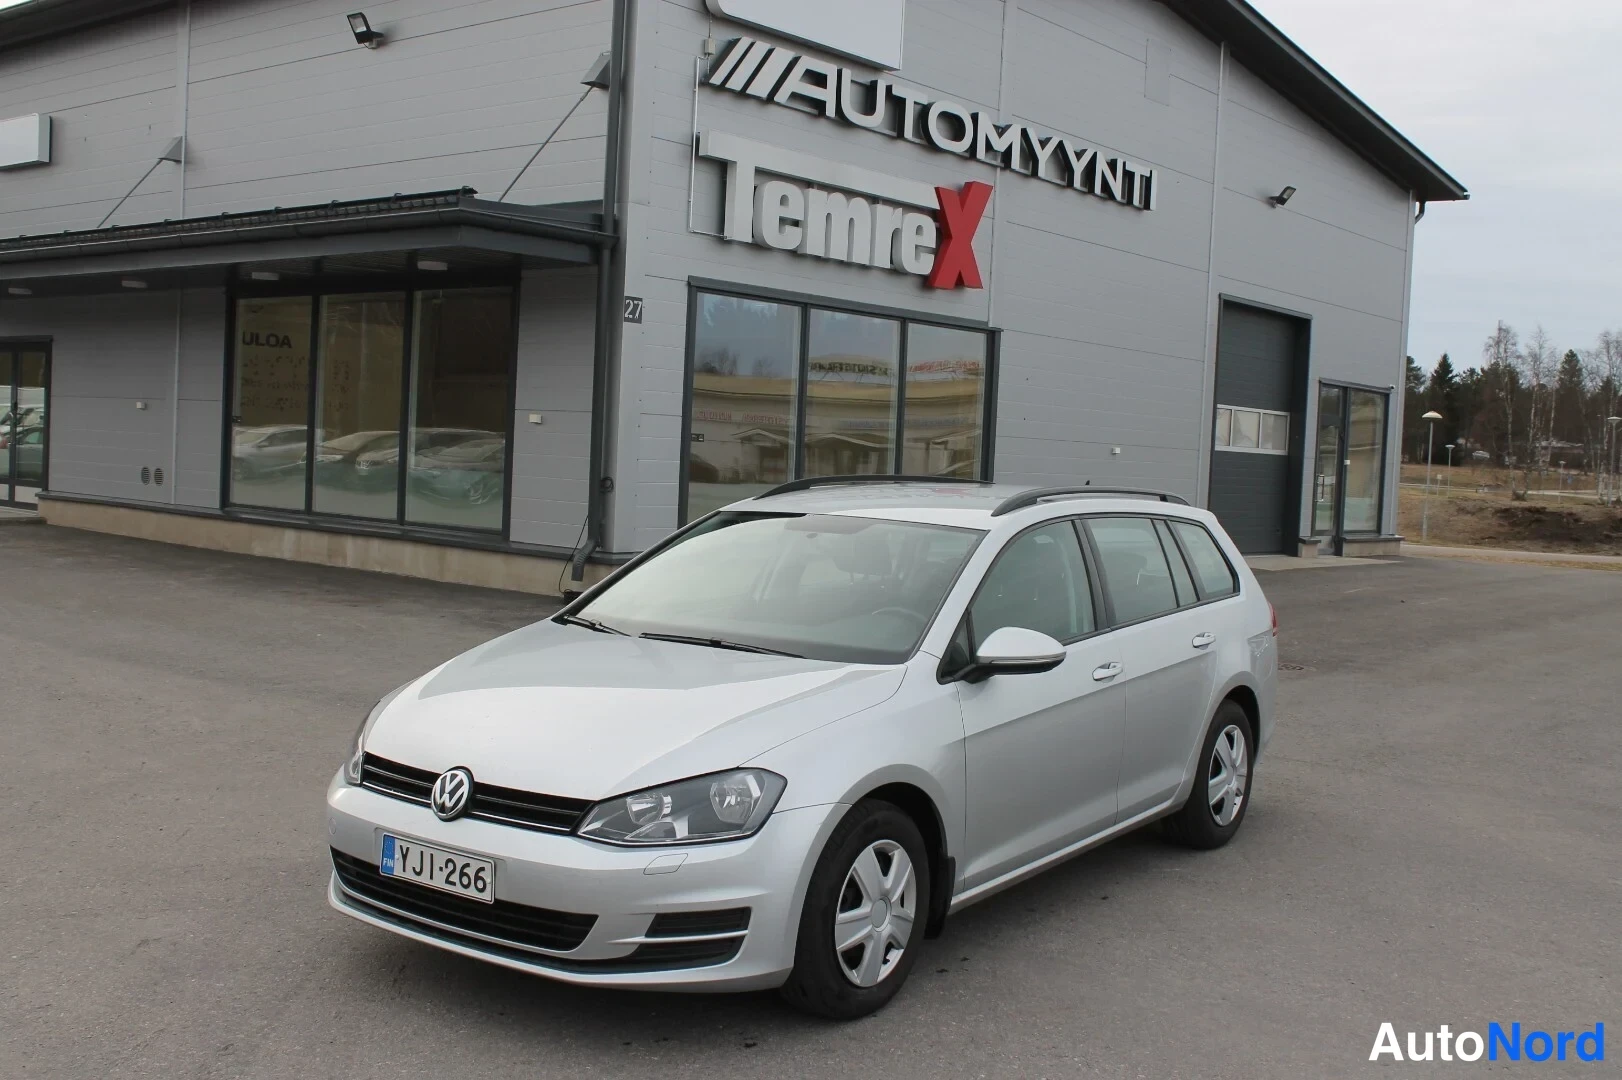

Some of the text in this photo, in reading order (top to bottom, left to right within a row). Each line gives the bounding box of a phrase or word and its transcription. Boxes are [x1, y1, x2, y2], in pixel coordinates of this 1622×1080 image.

[698, 129, 994, 290] TemreX
[624, 299, 643, 319] 27
[383, 856, 394, 868] FIN
[400, 844, 487, 893] YJI-266
